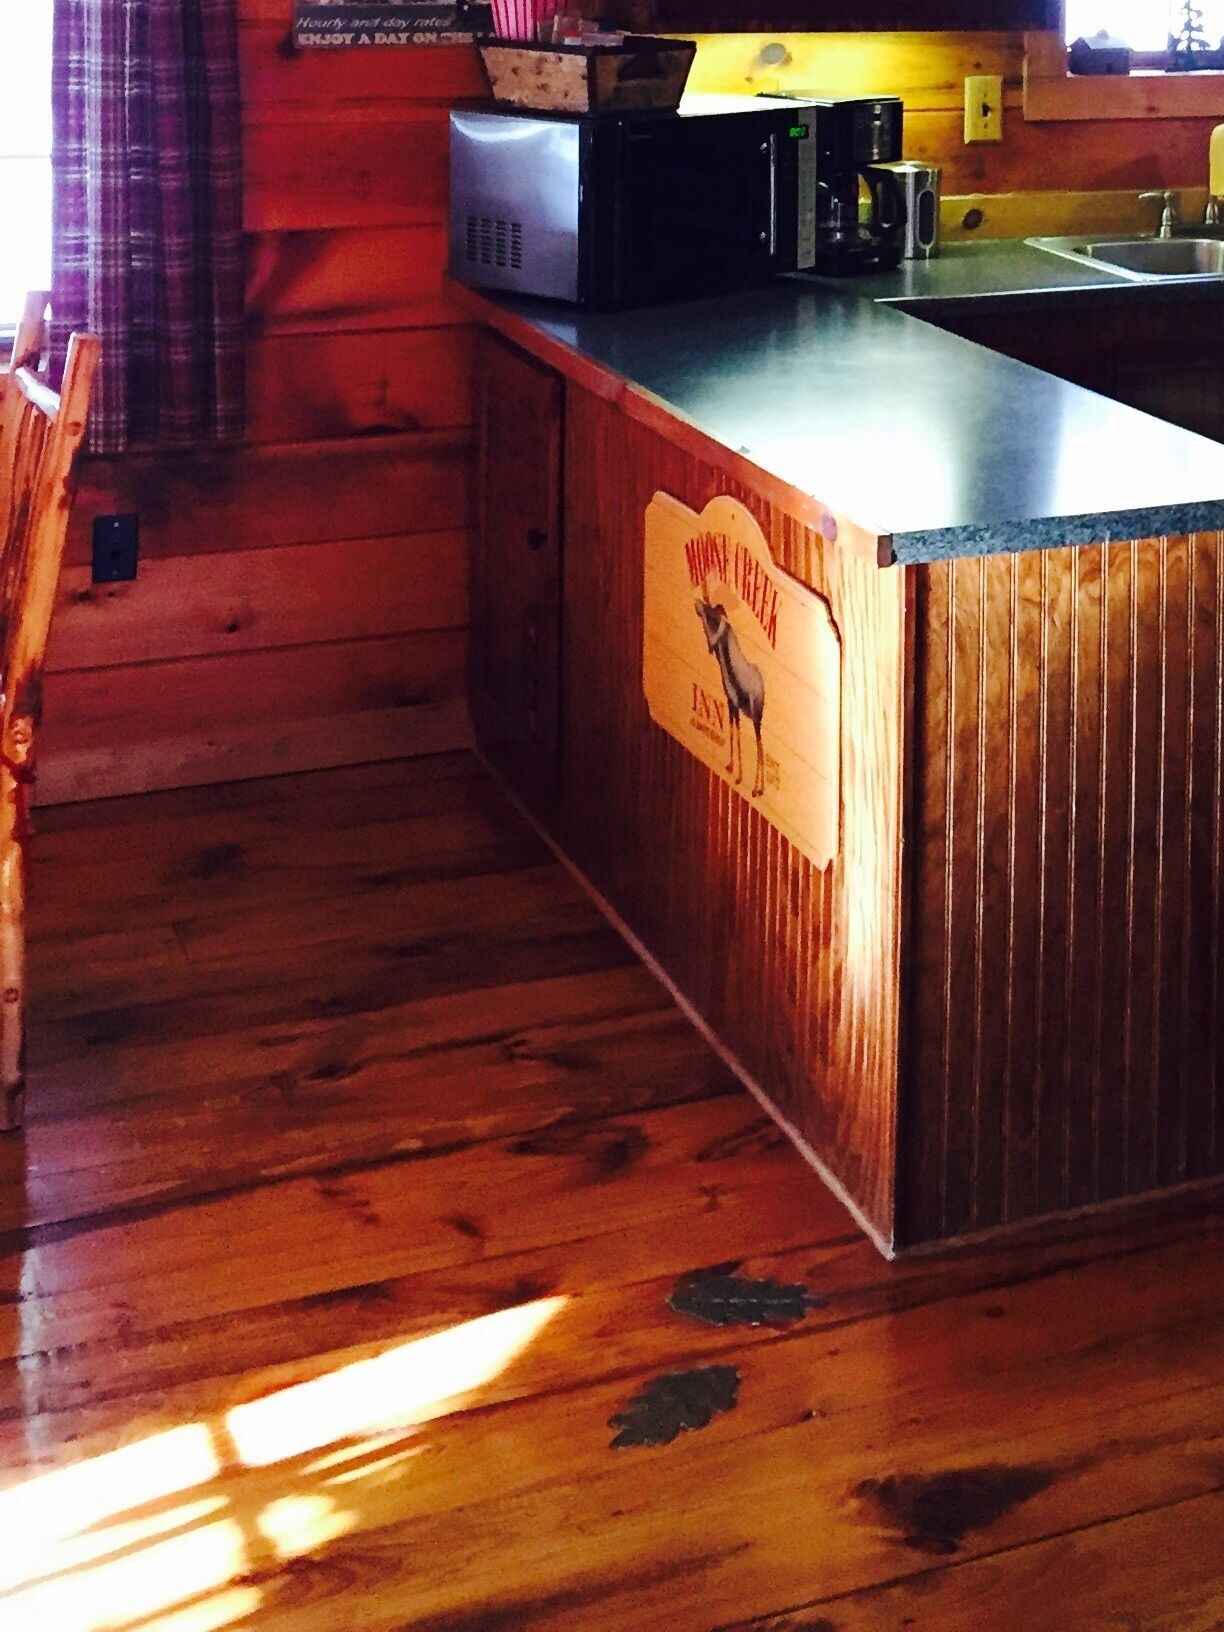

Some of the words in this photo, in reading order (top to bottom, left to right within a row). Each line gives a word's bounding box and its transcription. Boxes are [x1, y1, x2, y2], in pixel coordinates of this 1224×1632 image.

[296, 17, 345, 30] Hourly
[350, 17, 381, 28] and
[383, 17, 411, 30] day
[414, 17, 453, 28] rates
[297, 33, 355, 45] ENJOY
[358, 33, 372, 45] A
[374, 33, 410, 45] DAY
[412, 33, 438, 45] ON
[734, 542, 782, 650] CREEK
[692, 683, 725, 729] INN
